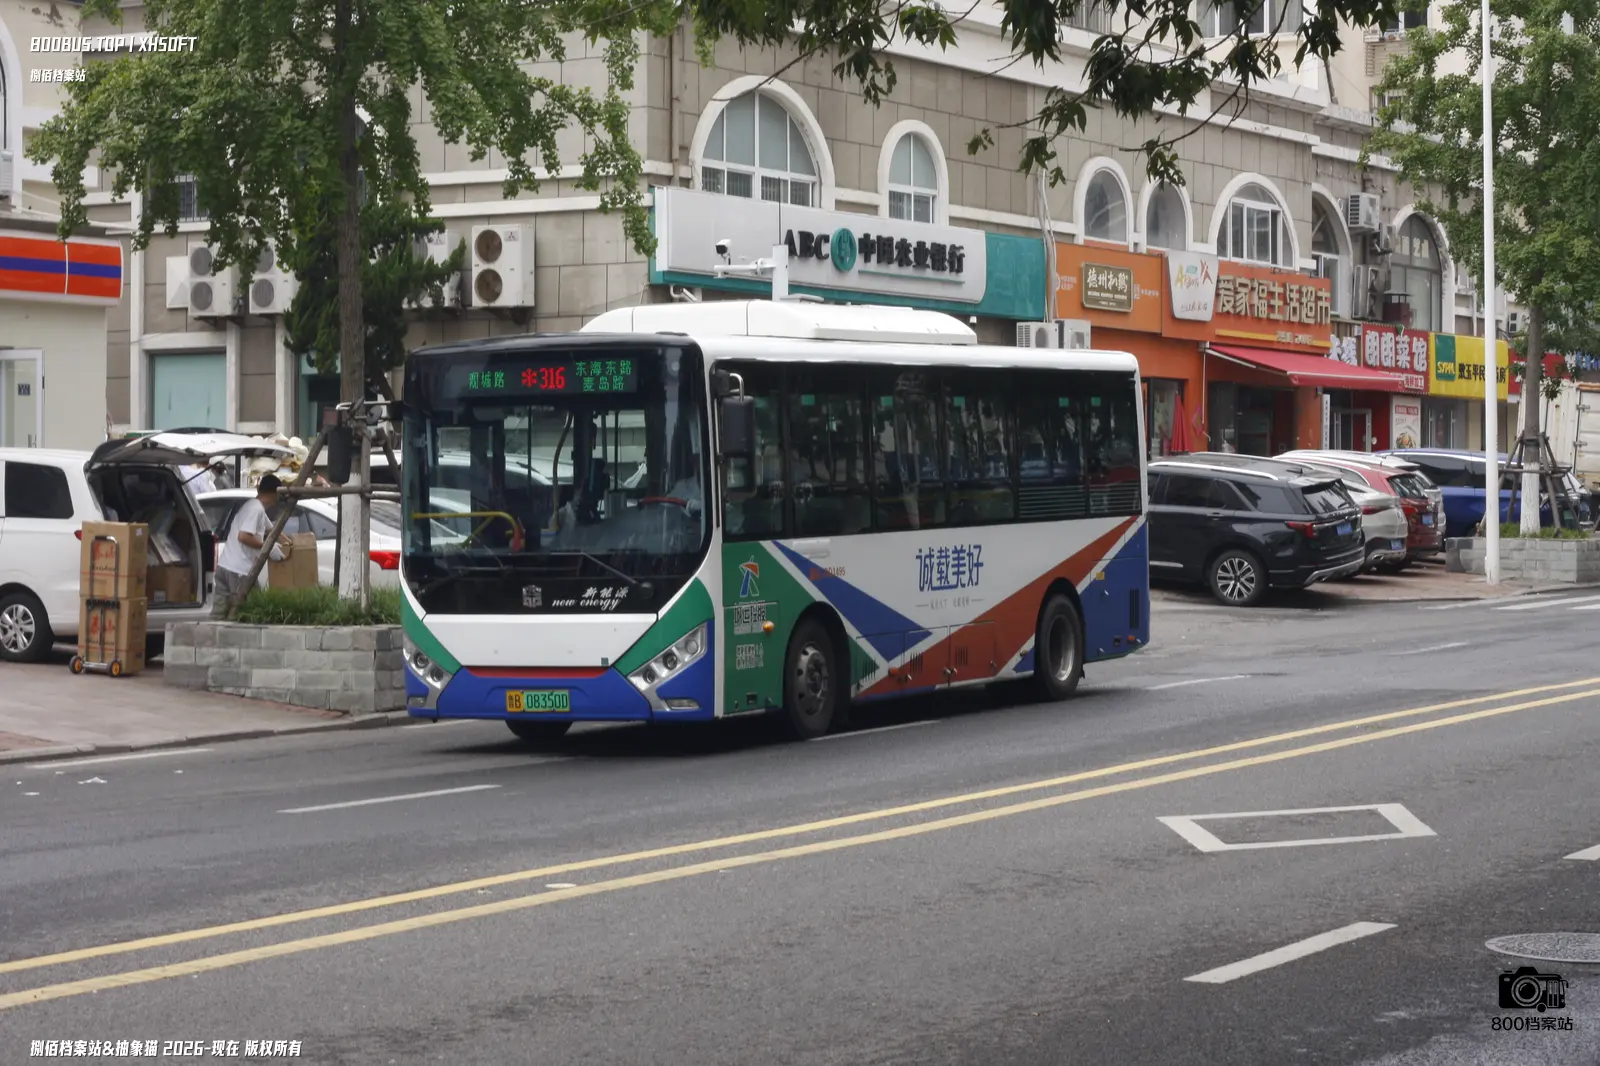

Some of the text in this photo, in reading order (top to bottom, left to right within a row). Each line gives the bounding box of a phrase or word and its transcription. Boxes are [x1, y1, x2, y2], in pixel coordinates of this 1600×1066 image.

[784, 229, 965, 274] ABC 中国农业银行
[1217, 274, 1330, 325] 爱家福生活超市
[1365, 330, 1427, 372] 朗朗菜馆
[575, 360, 632, 376] 东海东路
[468, 370, 505, 389] 观城路
[539, 367, 565, 389] 316
[583, 376, 624, 391] 麦岛路
[582, 586, 629, 598] 新能源
[552, 599, 619, 610] new energy
